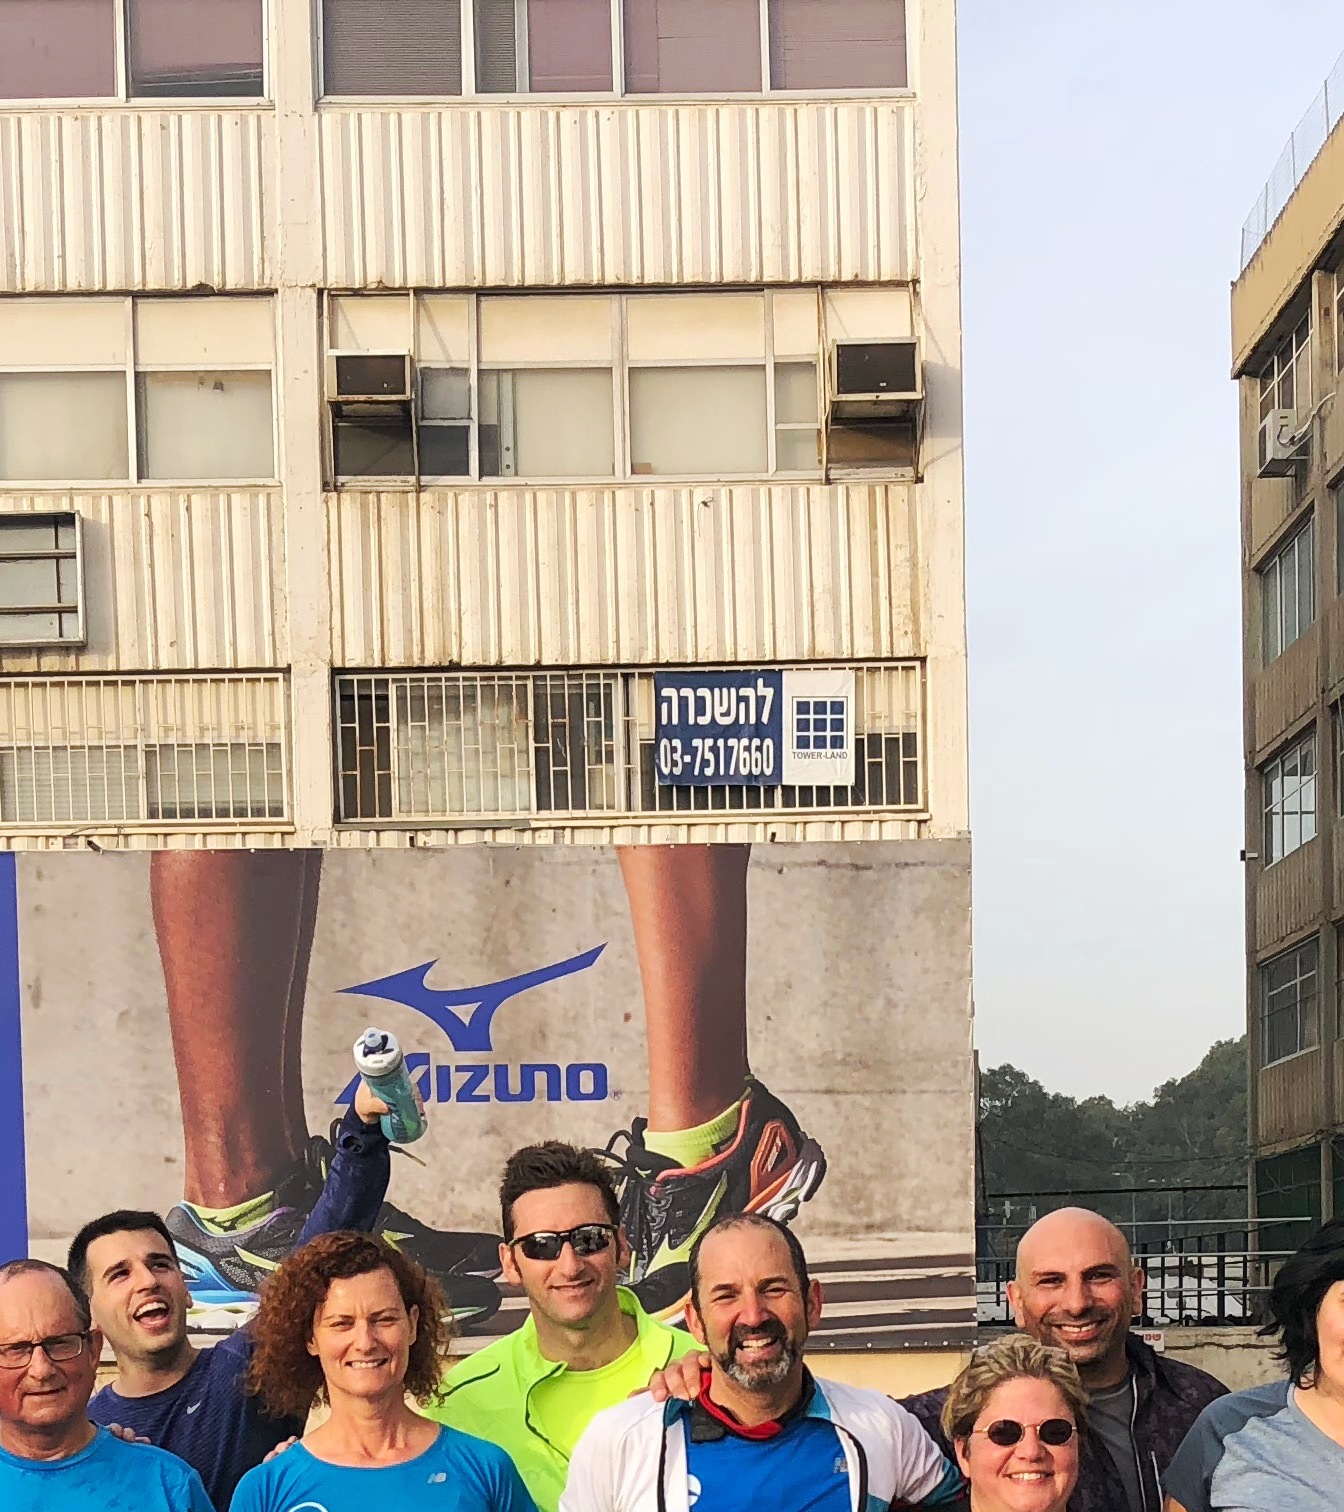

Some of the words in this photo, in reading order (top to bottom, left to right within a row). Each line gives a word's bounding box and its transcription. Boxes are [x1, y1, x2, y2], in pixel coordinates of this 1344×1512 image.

[660, 677, 775, 726] להשכרה
[659, 738, 774, 776] 03-7517660
[792, 751, 848, 760] TOWER-LAND
